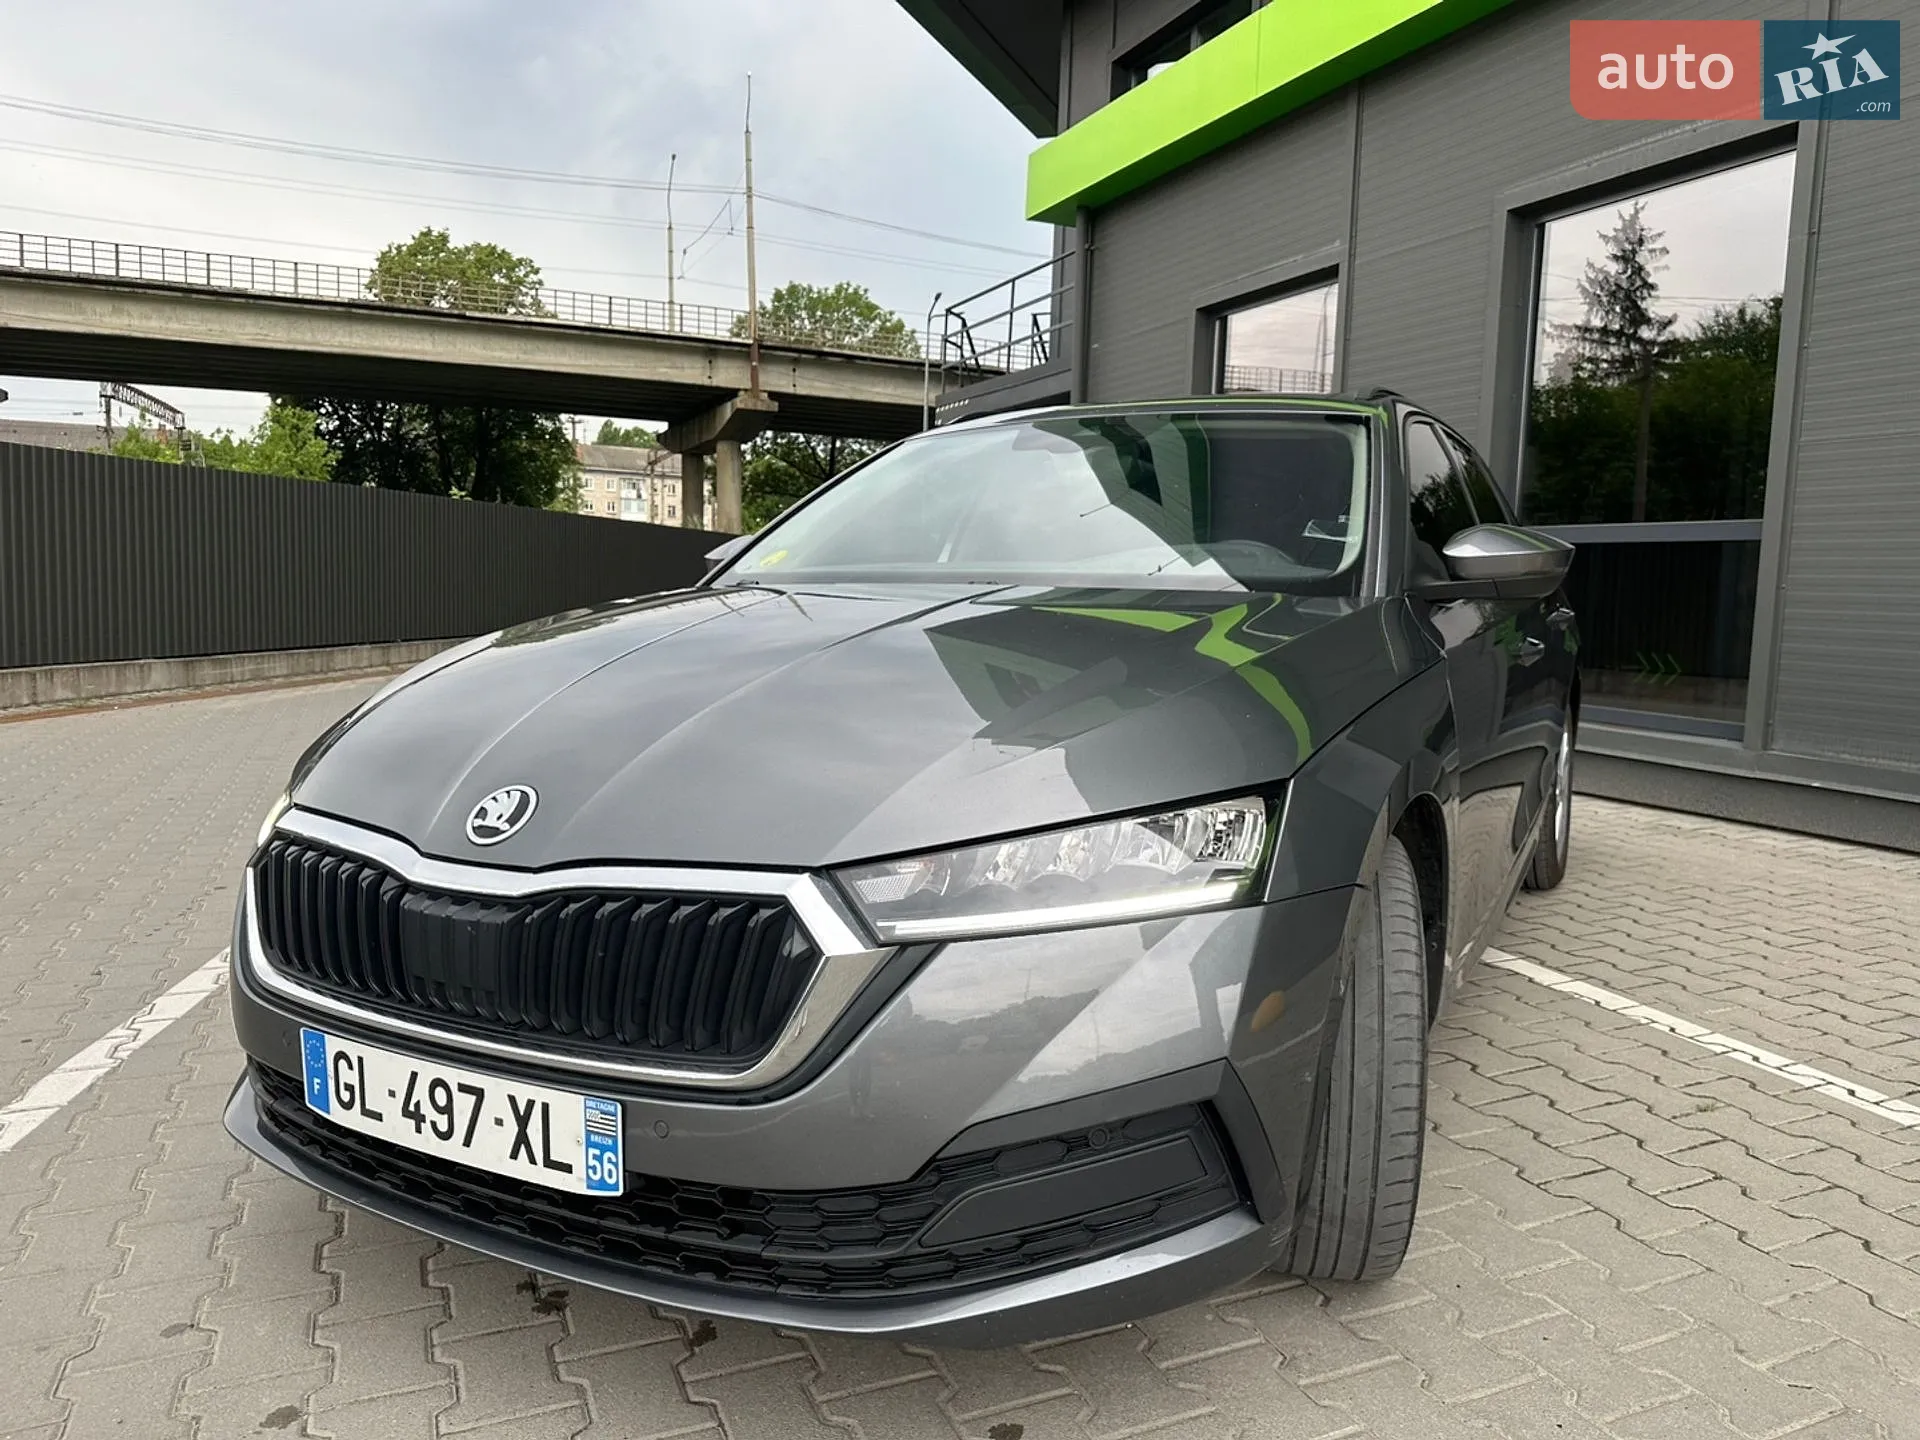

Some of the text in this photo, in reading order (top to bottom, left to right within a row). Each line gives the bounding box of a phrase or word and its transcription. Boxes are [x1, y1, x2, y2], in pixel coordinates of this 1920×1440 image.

[312, 1077, 321, 1095] F
[333, 1050, 573, 1174] GL-497-XL
[587, 1147, 618, 1185] 56
